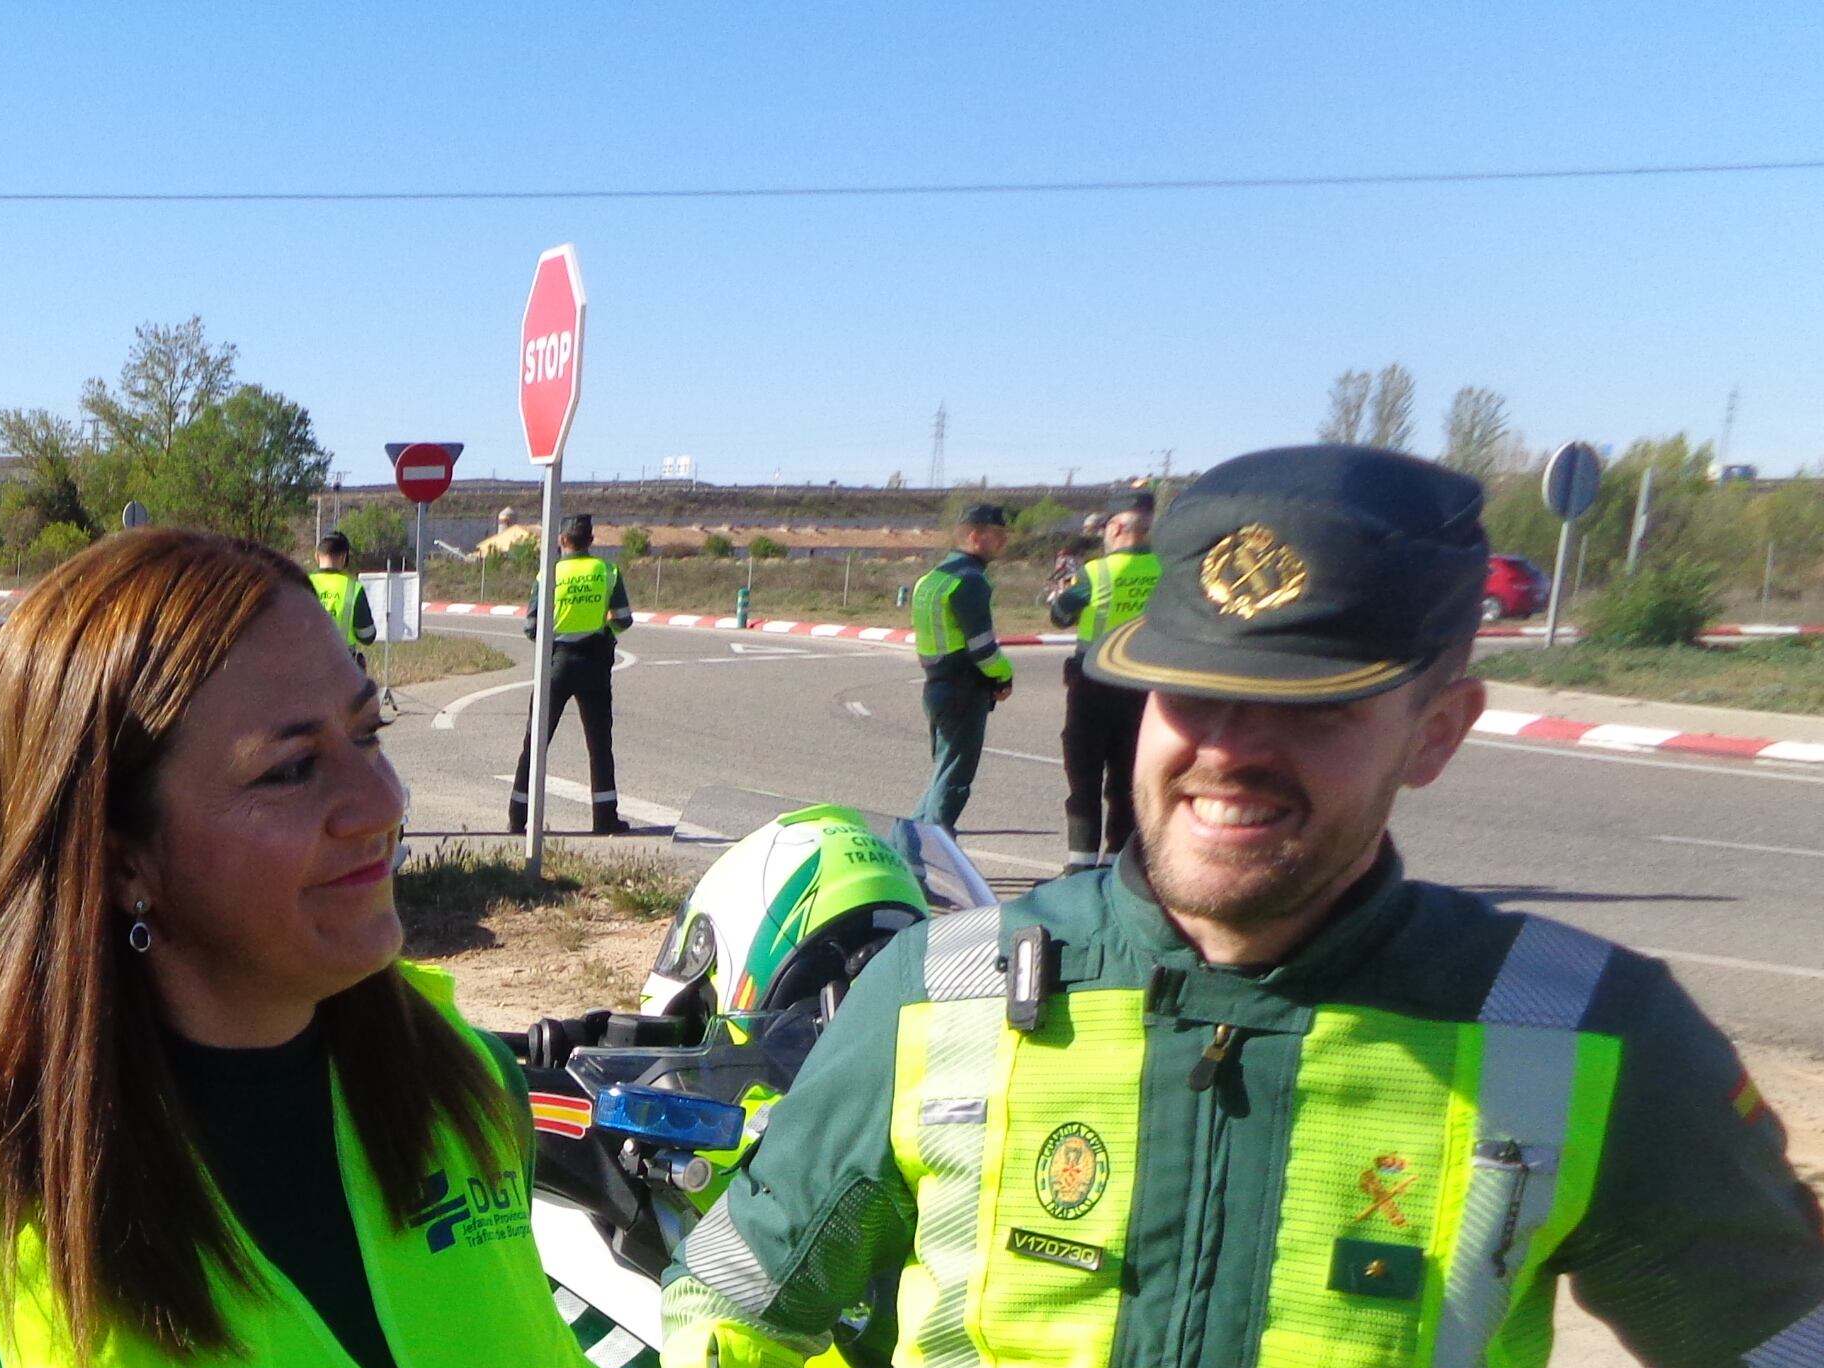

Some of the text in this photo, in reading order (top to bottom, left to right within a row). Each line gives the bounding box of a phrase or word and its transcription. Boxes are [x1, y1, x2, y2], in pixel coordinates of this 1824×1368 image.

[524, 330, 572, 385] STOP
[567, 583, 593, 594] CIVIL
[466, 1170, 522, 1213] DGT
